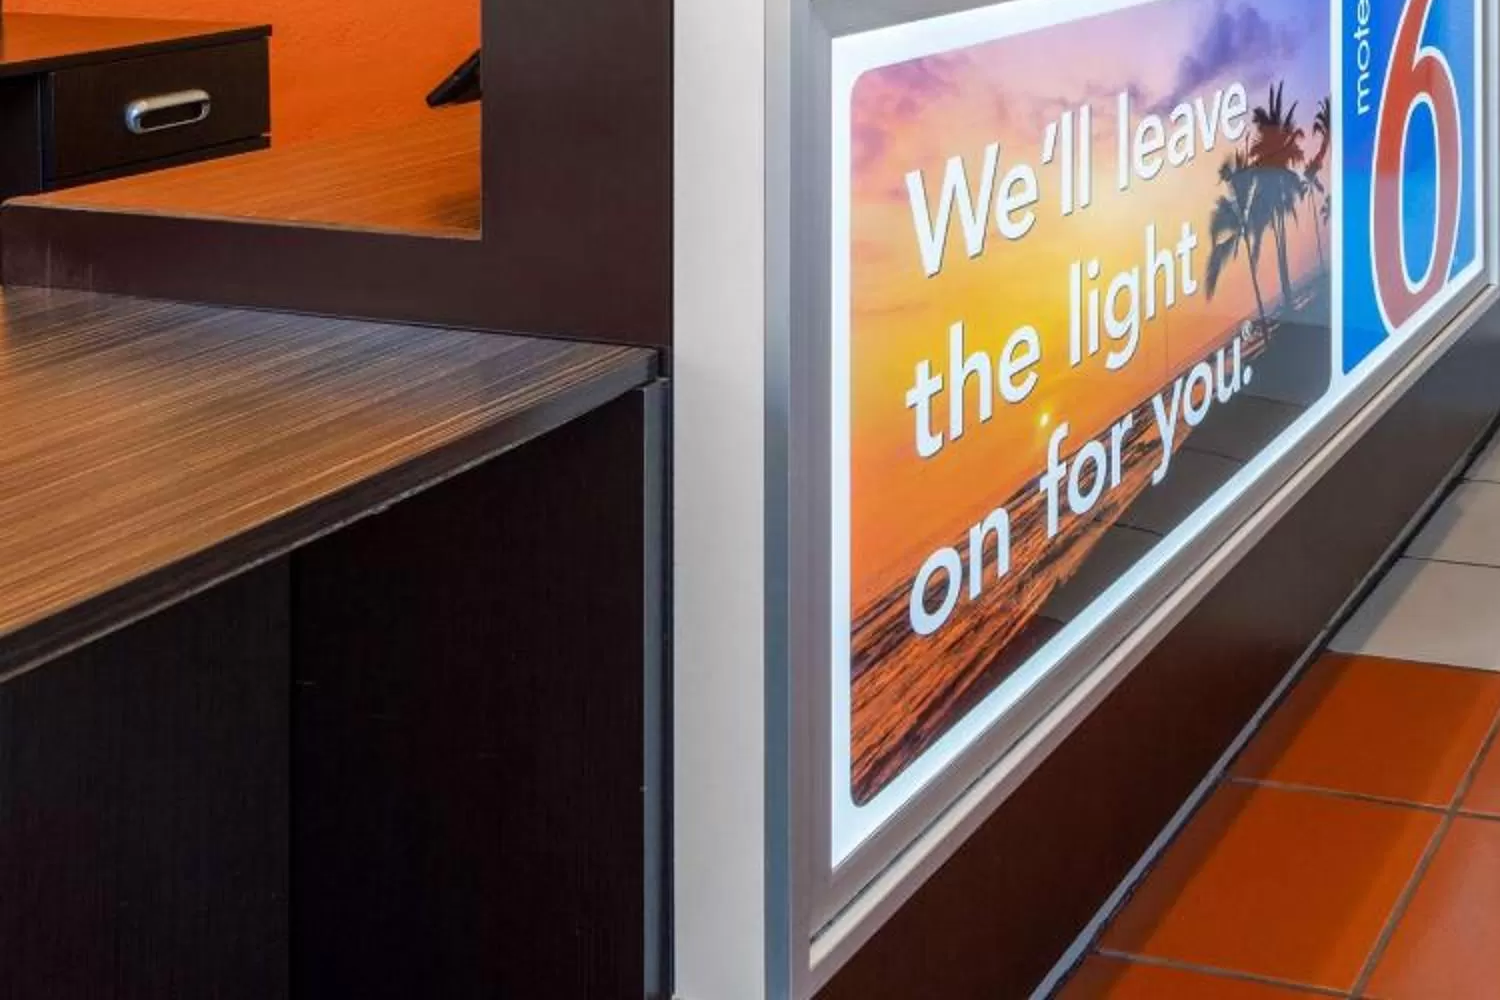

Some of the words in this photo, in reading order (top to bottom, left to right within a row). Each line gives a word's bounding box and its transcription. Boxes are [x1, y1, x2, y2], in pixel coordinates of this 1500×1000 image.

[905, 104, 1093, 278] We'll
[1118, 81, 1248, 191] leave
[906, 321, 1041, 459] the
[1069, 221, 1199, 369] light
[909, 506, 1011, 636] on
[1039, 421, 1134, 538] for
